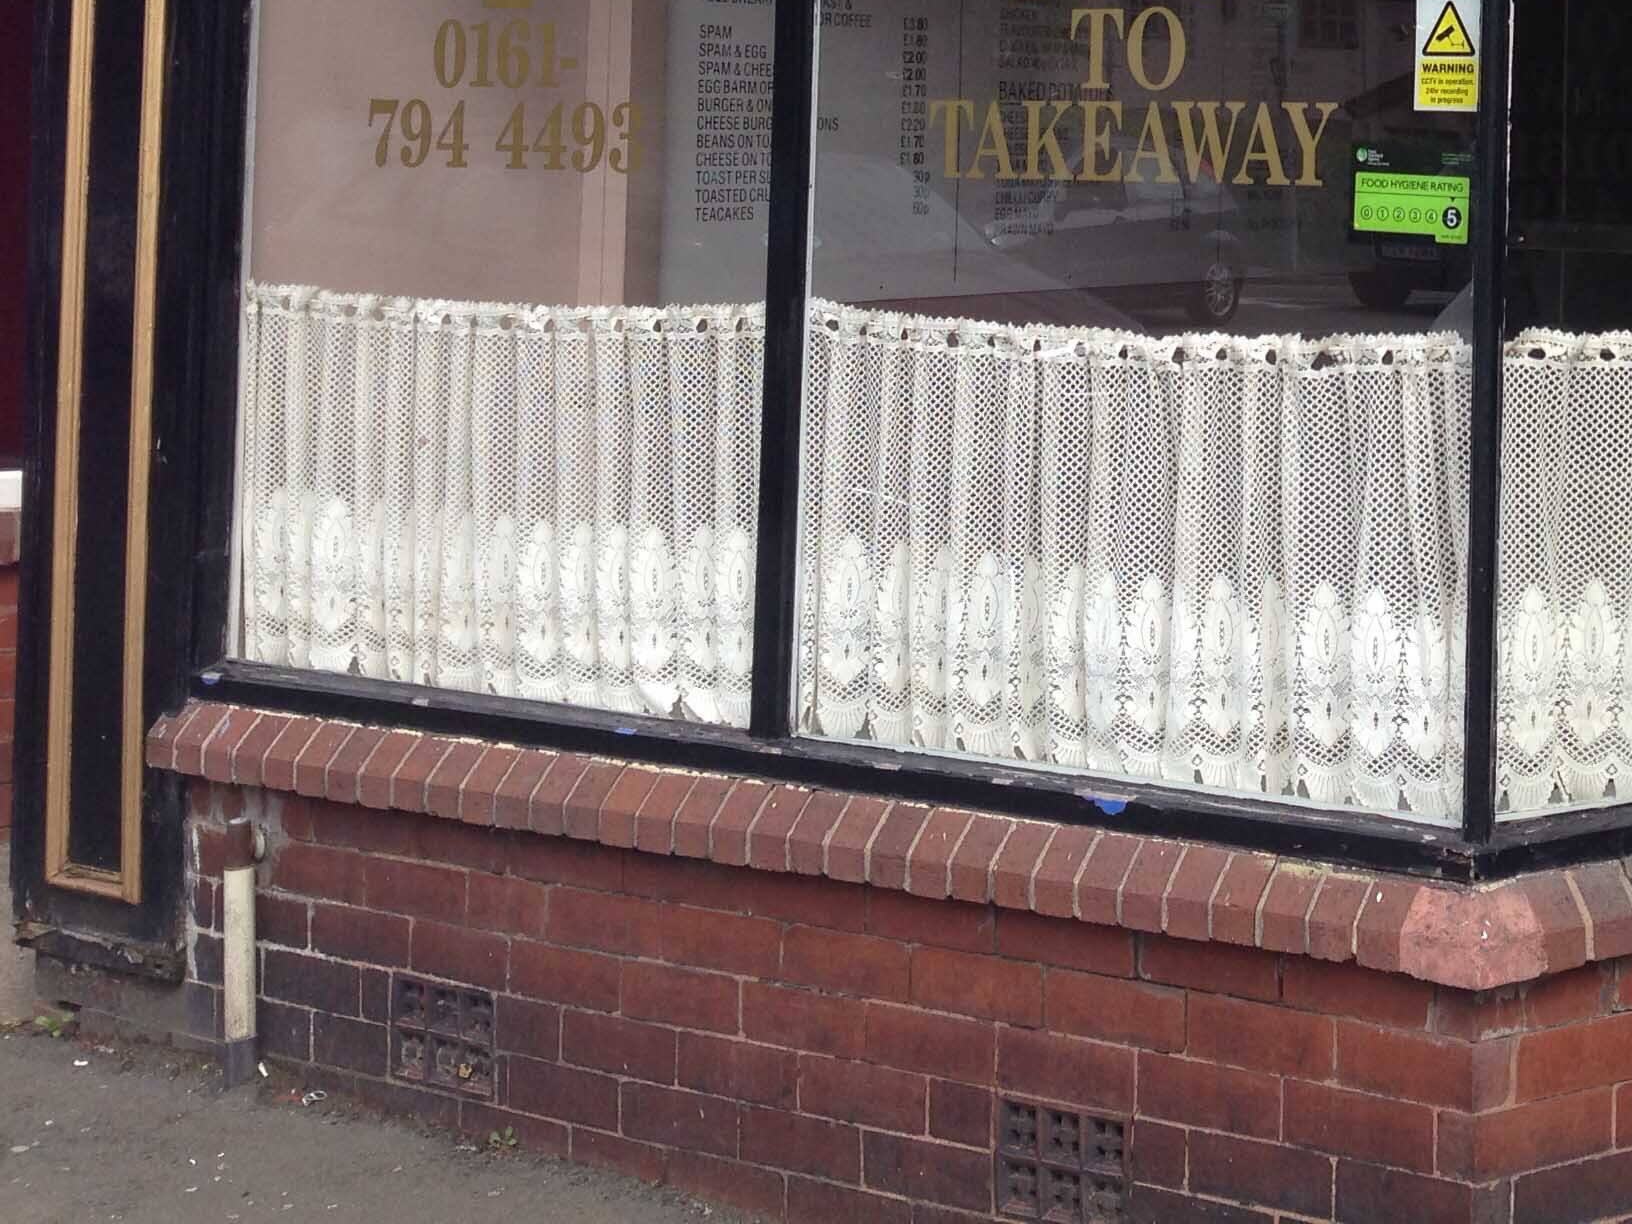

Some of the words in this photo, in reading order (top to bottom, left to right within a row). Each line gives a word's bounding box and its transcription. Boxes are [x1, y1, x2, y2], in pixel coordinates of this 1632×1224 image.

[699, 24, 732, 39] SPAM
[433, 19, 577, 89] 0161-
[698, 42, 732, 57] SPAM
[734, 44, 742, 58] &
[744, 44, 767, 59] EGG
[1071, 6, 1186, 91] TO
[698, 61, 731, 76] SPAM
[734, 62, 741, 76] &
[1422, 63, 1474, 73] WARNING
[697, 79, 721, 94] EGG
[723, 79, 757, 95] BARM
[1000, 81, 1045, 100] BAKED
[697, 97, 744, 112] BURGER
[745, 98, 754, 112] &
[697, 115, 740, 130] CHEESE
[369, 99, 469, 168] 794
[495, 101, 642, 174] 4493
[696, 133, 735, 148] BEANS
[737, 134, 753, 149] ON
[929, 100, 1338, 187] TAKEAWAY
[696, 152, 739, 167] CHEESE
[742, 152, 757, 166] ON
[696, 170, 732, 185] TOAST
[735, 171, 757, 185] PER
[1362, 178, 1389, 188] FOOD
[1391, 180, 1429, 191] HYGIENE
[1430, 181, 1463, 192] RATING
[695, 188, 746, 204] TOASTED
[695, 206, 754, 222] TEACAKES
[1446, 210, 1457, 226] 5
